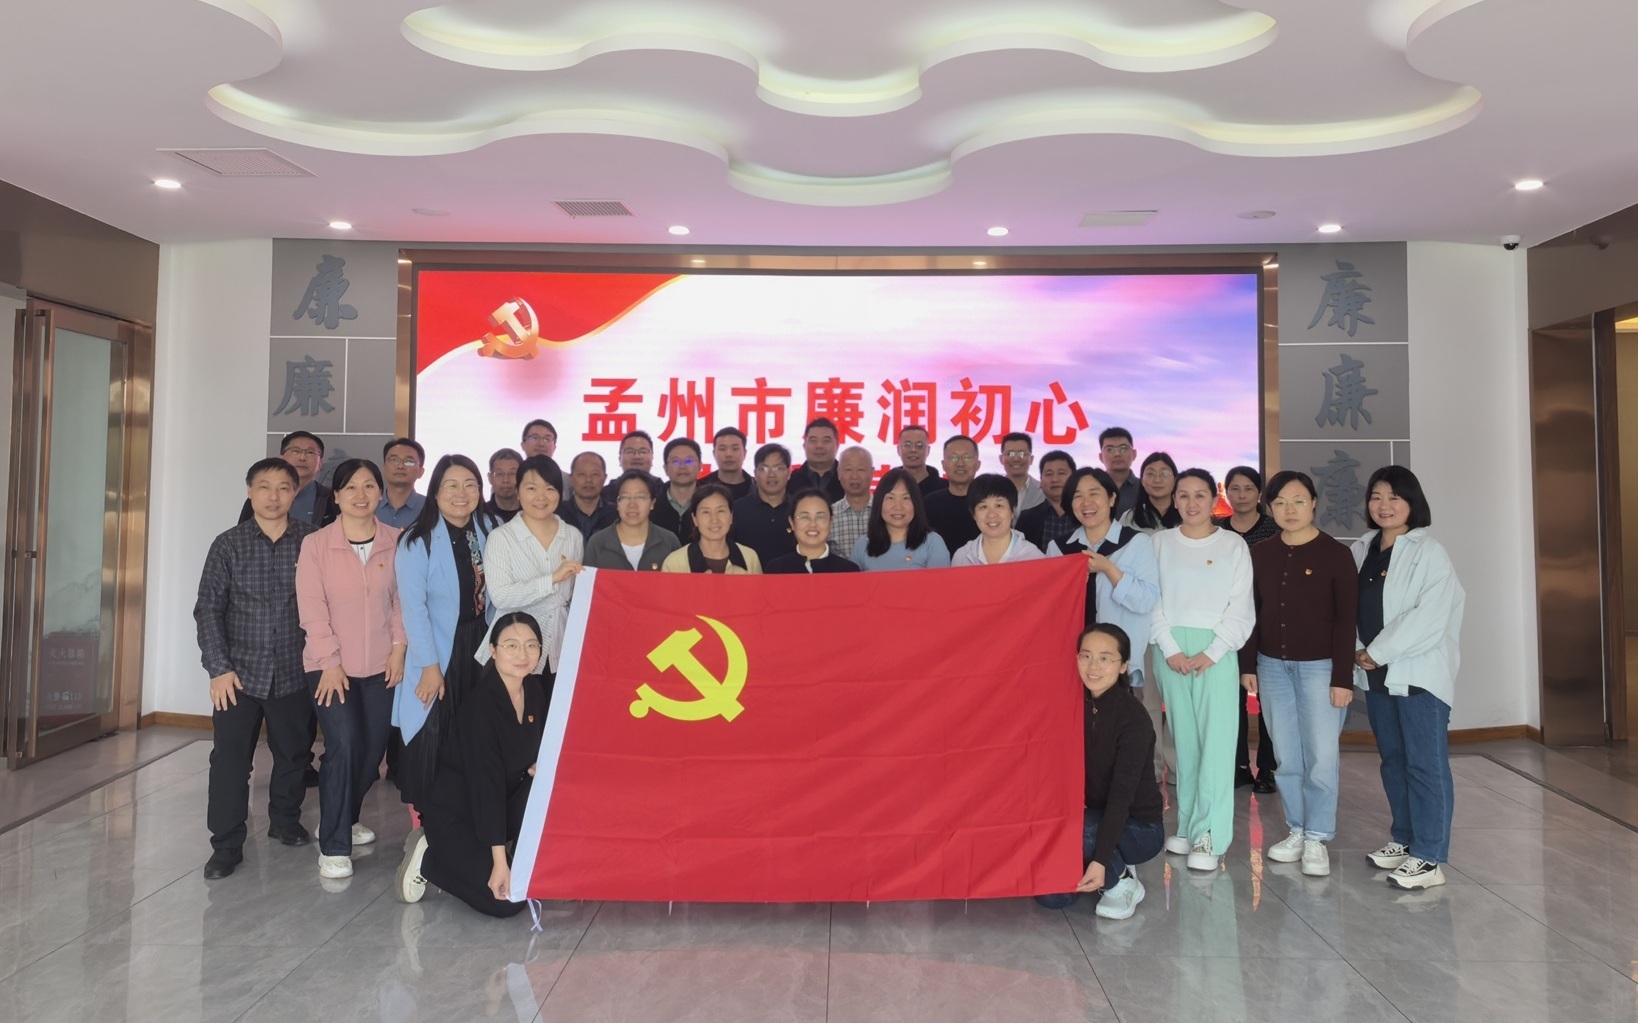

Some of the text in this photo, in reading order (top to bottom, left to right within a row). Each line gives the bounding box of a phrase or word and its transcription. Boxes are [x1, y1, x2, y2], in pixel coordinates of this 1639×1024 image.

[581, 376, 1090, 444] 孟州市廉润初心
